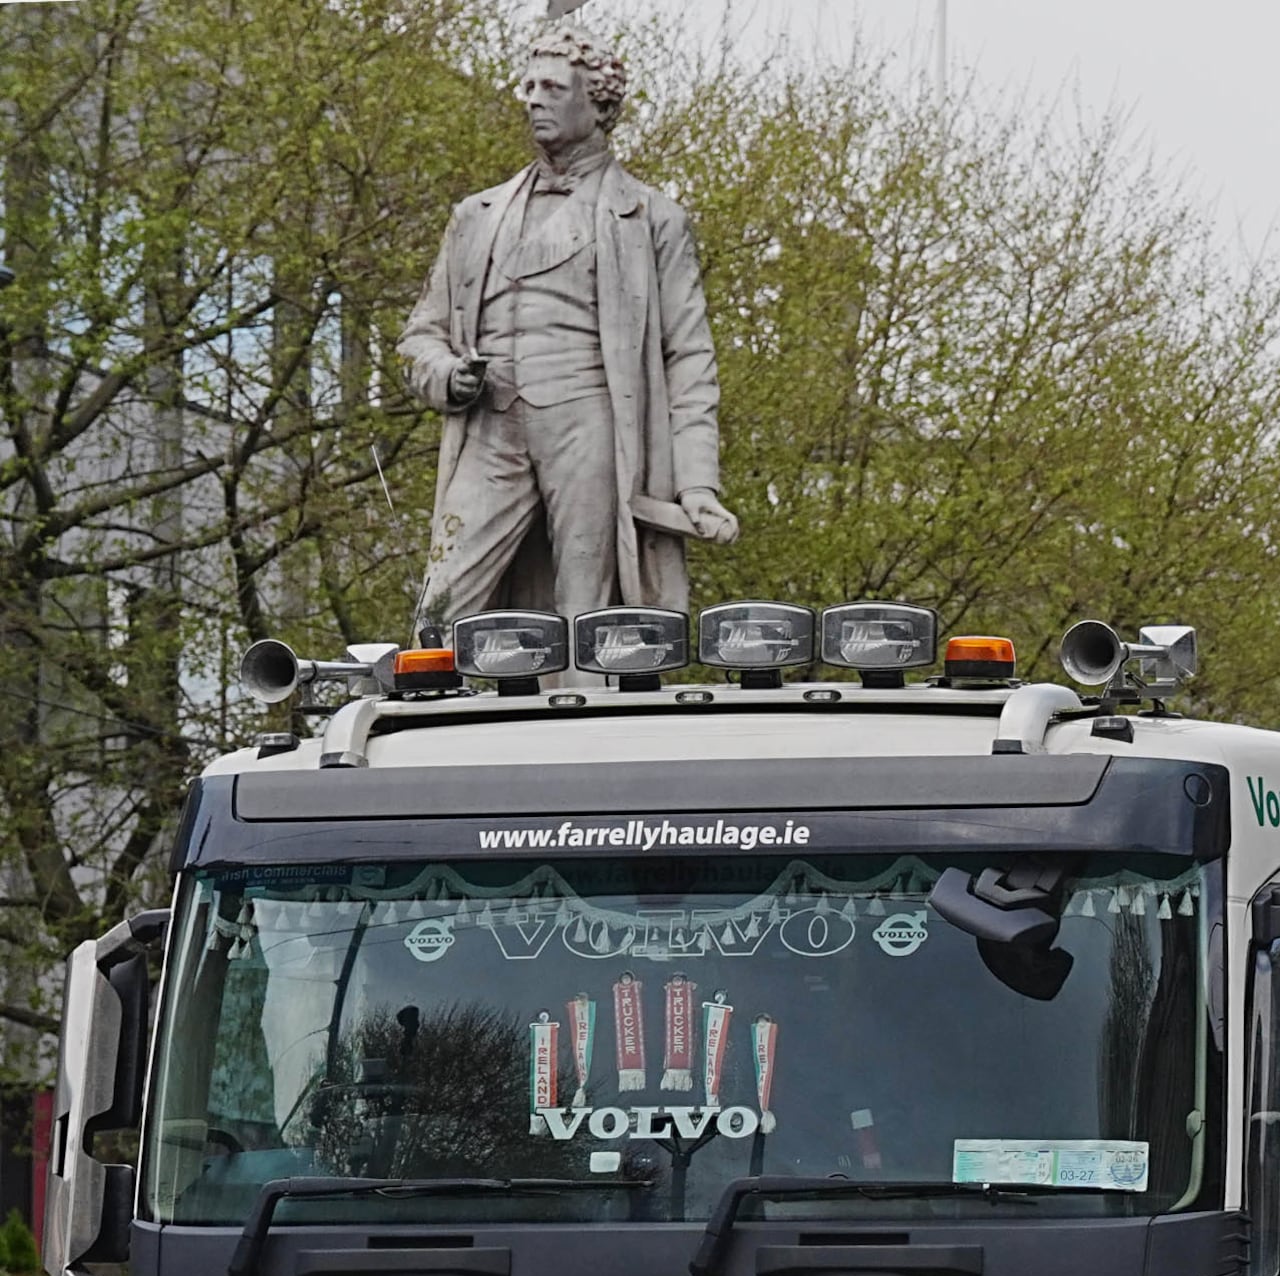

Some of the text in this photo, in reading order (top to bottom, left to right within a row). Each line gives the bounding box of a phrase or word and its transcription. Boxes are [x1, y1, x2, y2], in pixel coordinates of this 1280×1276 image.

[478, 820, 810, 851] www.farrellyhaulage.ie
[408, 937, 453, 945] VOLVO
[477, 908, 856, 960] VOLVO
[877, 930, 926, 940] VOLVO
[621, 989, 637, 1055] TRUCKER
[672, 989, 685, 1054] TRUCKER
[536, 1036, 549, 1105] IRELAND
[706, 1020, 719, 1085] IRELAND
[535, 1106, 758, 1140] VOLVO
[1060, 1170, 1095, 1181] 03-27
